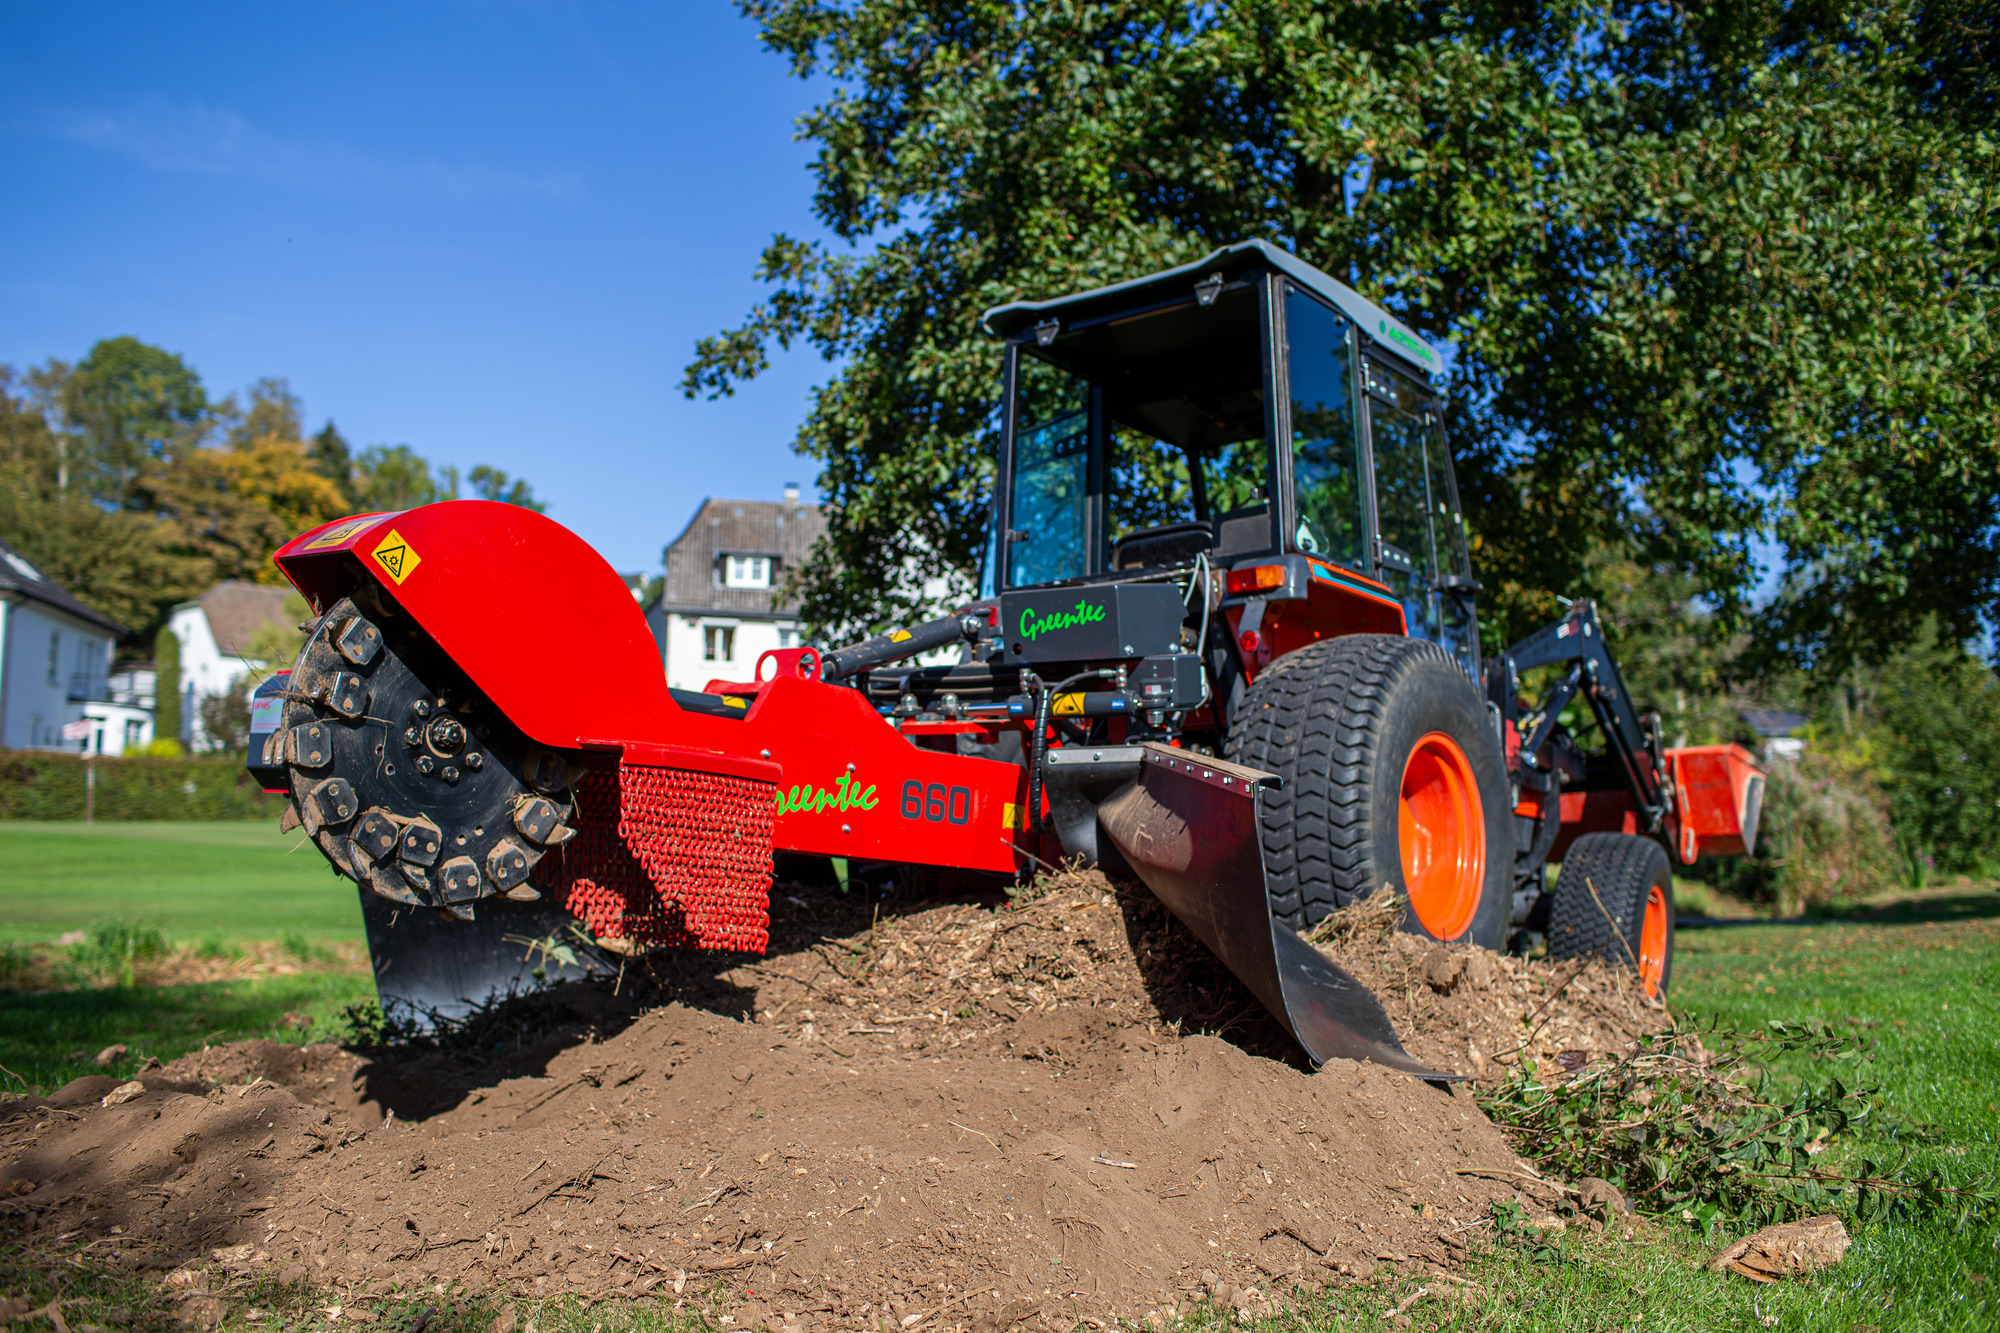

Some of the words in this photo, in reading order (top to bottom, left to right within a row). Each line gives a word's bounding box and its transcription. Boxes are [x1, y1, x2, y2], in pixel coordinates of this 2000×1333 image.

[1019, 599, 1106, 641] Greentec
[773, 771, 879, 816] reentec
[901, 779, 971, 825] 660
